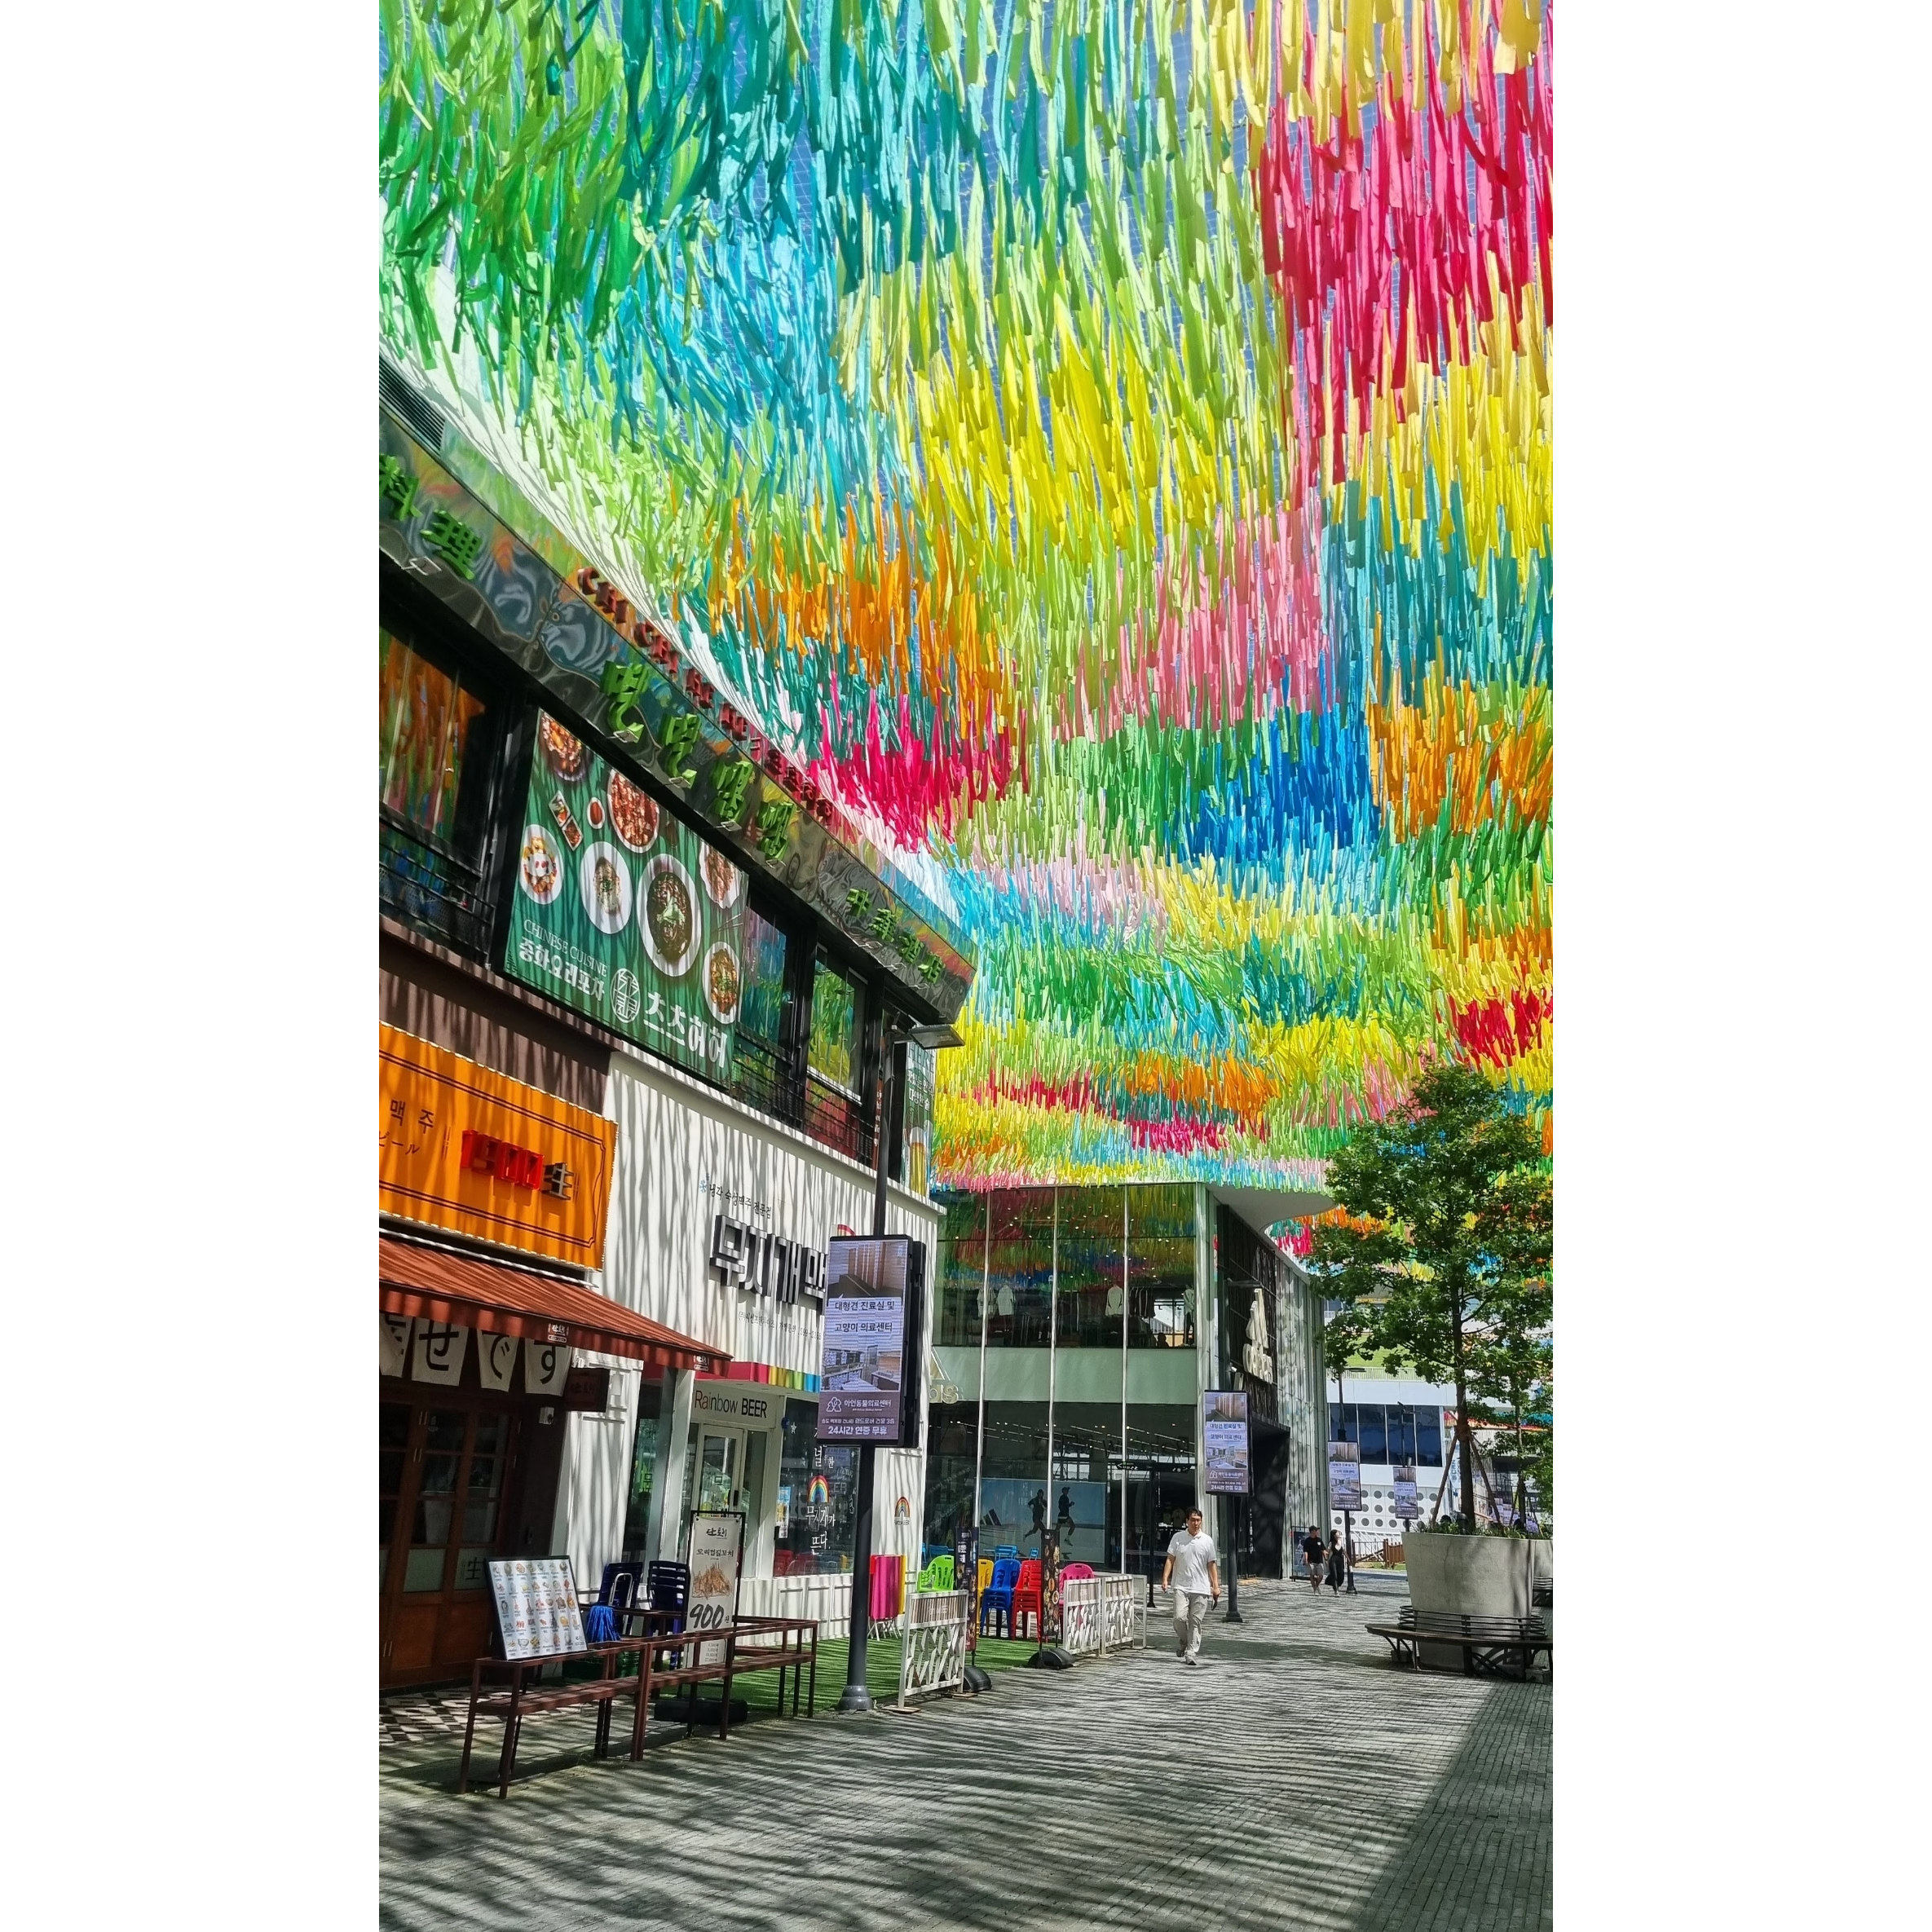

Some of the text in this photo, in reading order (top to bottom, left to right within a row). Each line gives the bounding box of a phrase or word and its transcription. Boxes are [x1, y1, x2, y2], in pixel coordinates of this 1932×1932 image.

[523, 919, 607, 977] CHINESE CUISINE
[518, 936, 605, 1002] 중화요리포차
[643, 991, 728, 1069] 츠츠허허
[709, 1184, 723, 1201] 냉각
[753, 1202, 772, 1220] 전문점
[835, 1301, 895, 1311] 대형견 진료실 및
[835, 1322, 893, 1332] 고양이 의료센터
[695, 1390, 768, 1418] Rainbow BEER
[828, 1426, 854, 1435] 24시간
[855, 1427, 871, 1435] 연중
[872, 1426, 888, 1435] 무휴
[805, 1506, 836, 1530] 무지개가
[690, 1603, 724, 1629] 900
